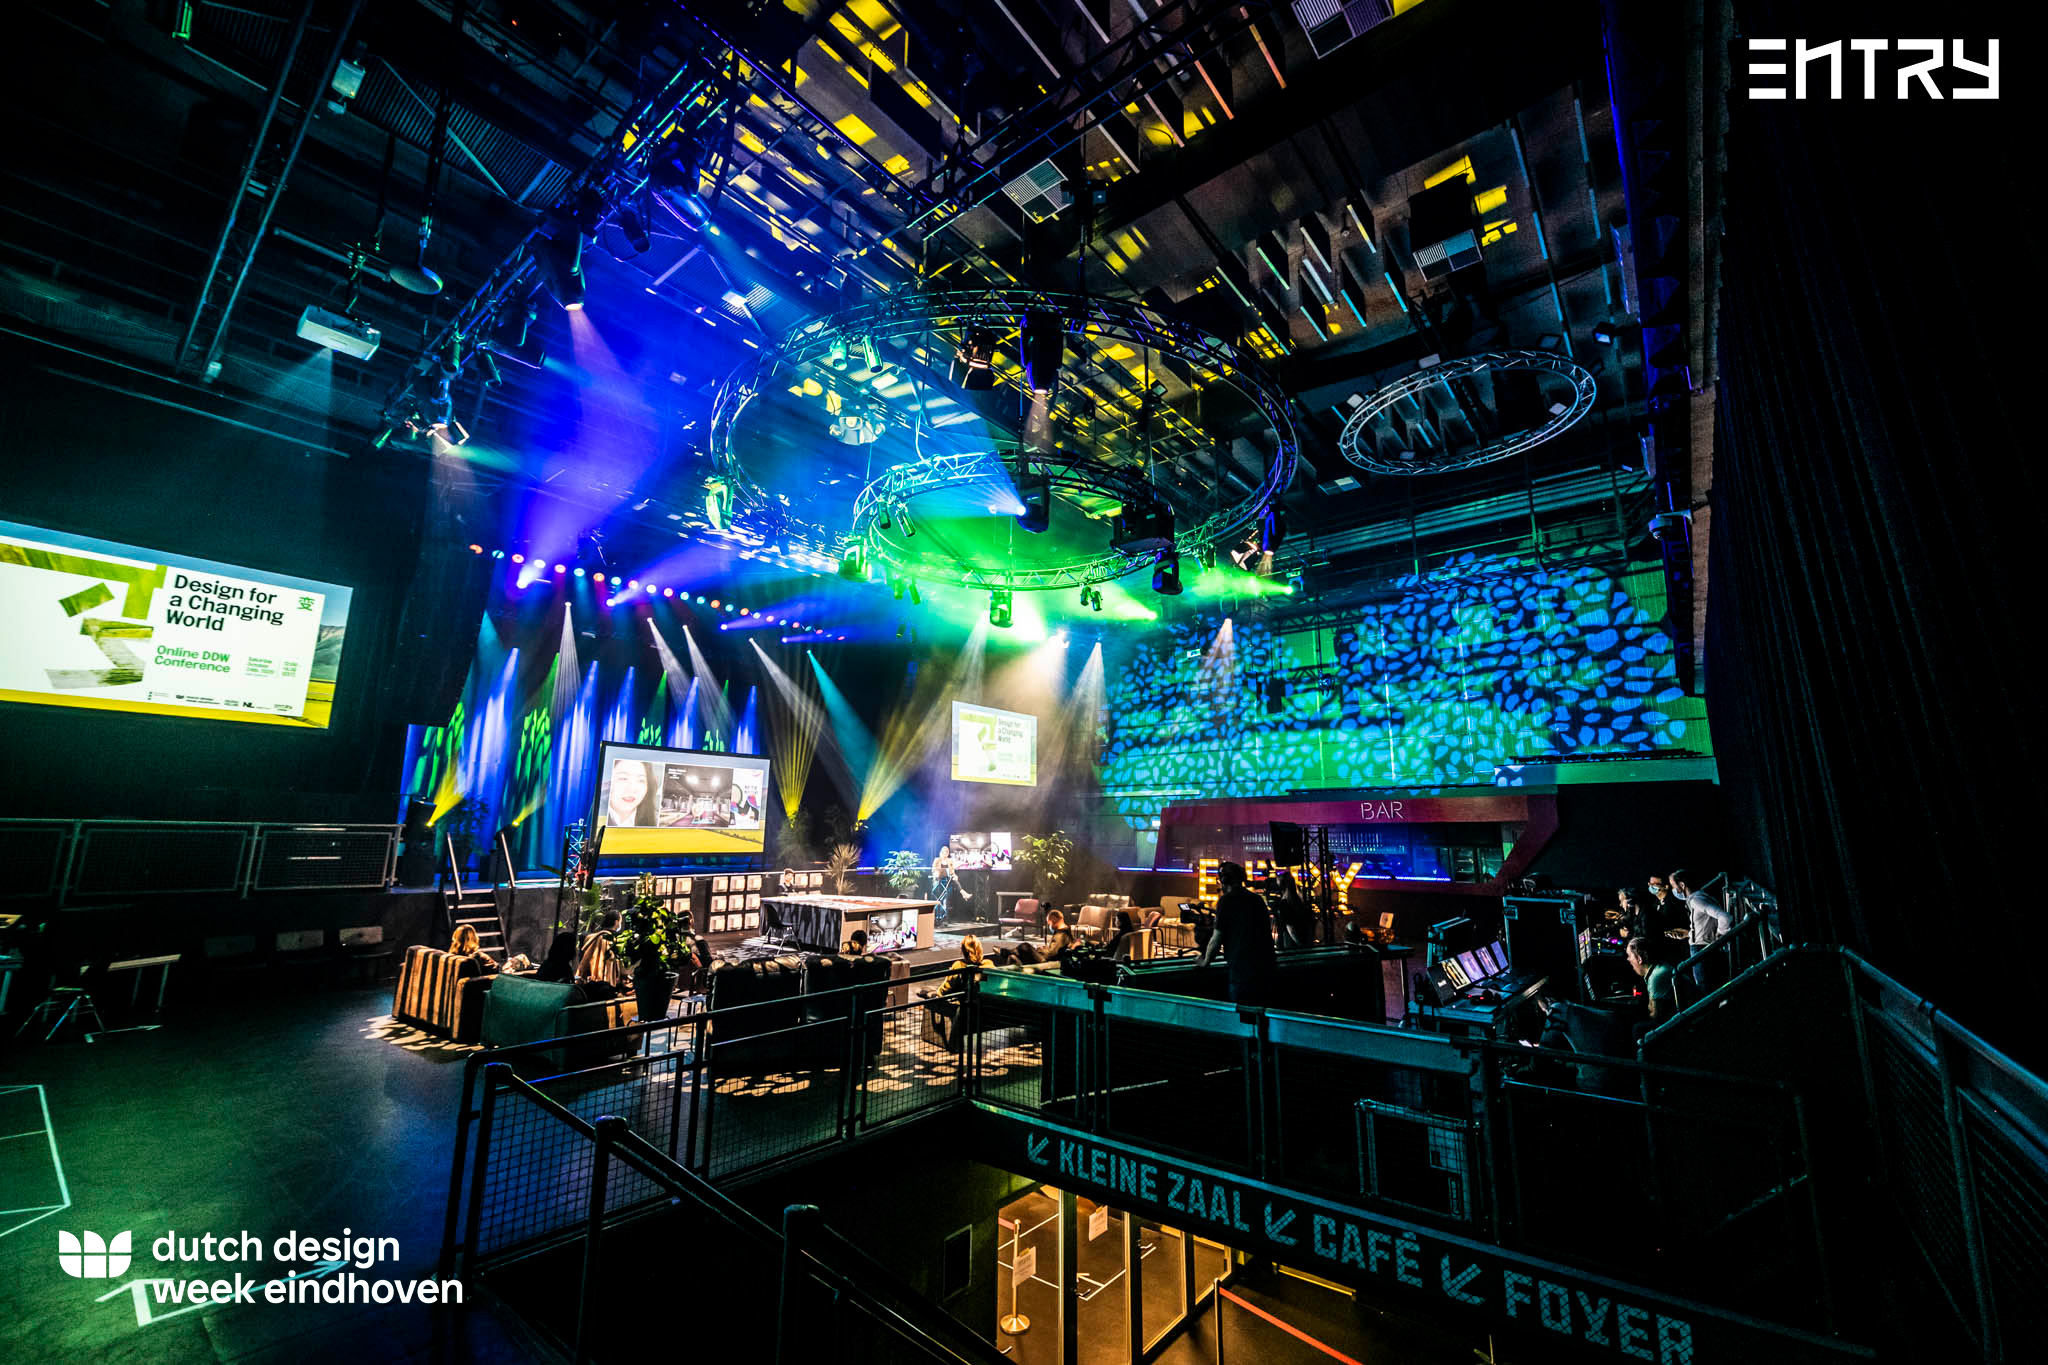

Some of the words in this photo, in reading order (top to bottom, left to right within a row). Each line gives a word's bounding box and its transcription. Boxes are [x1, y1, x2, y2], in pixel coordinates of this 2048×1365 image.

[174, 574, 244, 600] Design
[249, 588, 277, 604] for
[166, 609, 224, 631] World
[169, 595, 182, 607] a
[188, 595, 284, 626] Changing
[154, 655, 231, 673] Conference
[157, 645, 199, 659] Online
[202, 651, 230, 662] DDW
[1361, 801, 1403, 820] BAR
[1059, 1139, 1158, 1203] KLEINE
[1167, 1171, 1250, 1233] ZAAL
[1313, 1214, 1422, 1288] CAFÉ
[1503, 1269, 1693, 1365] FOYER
